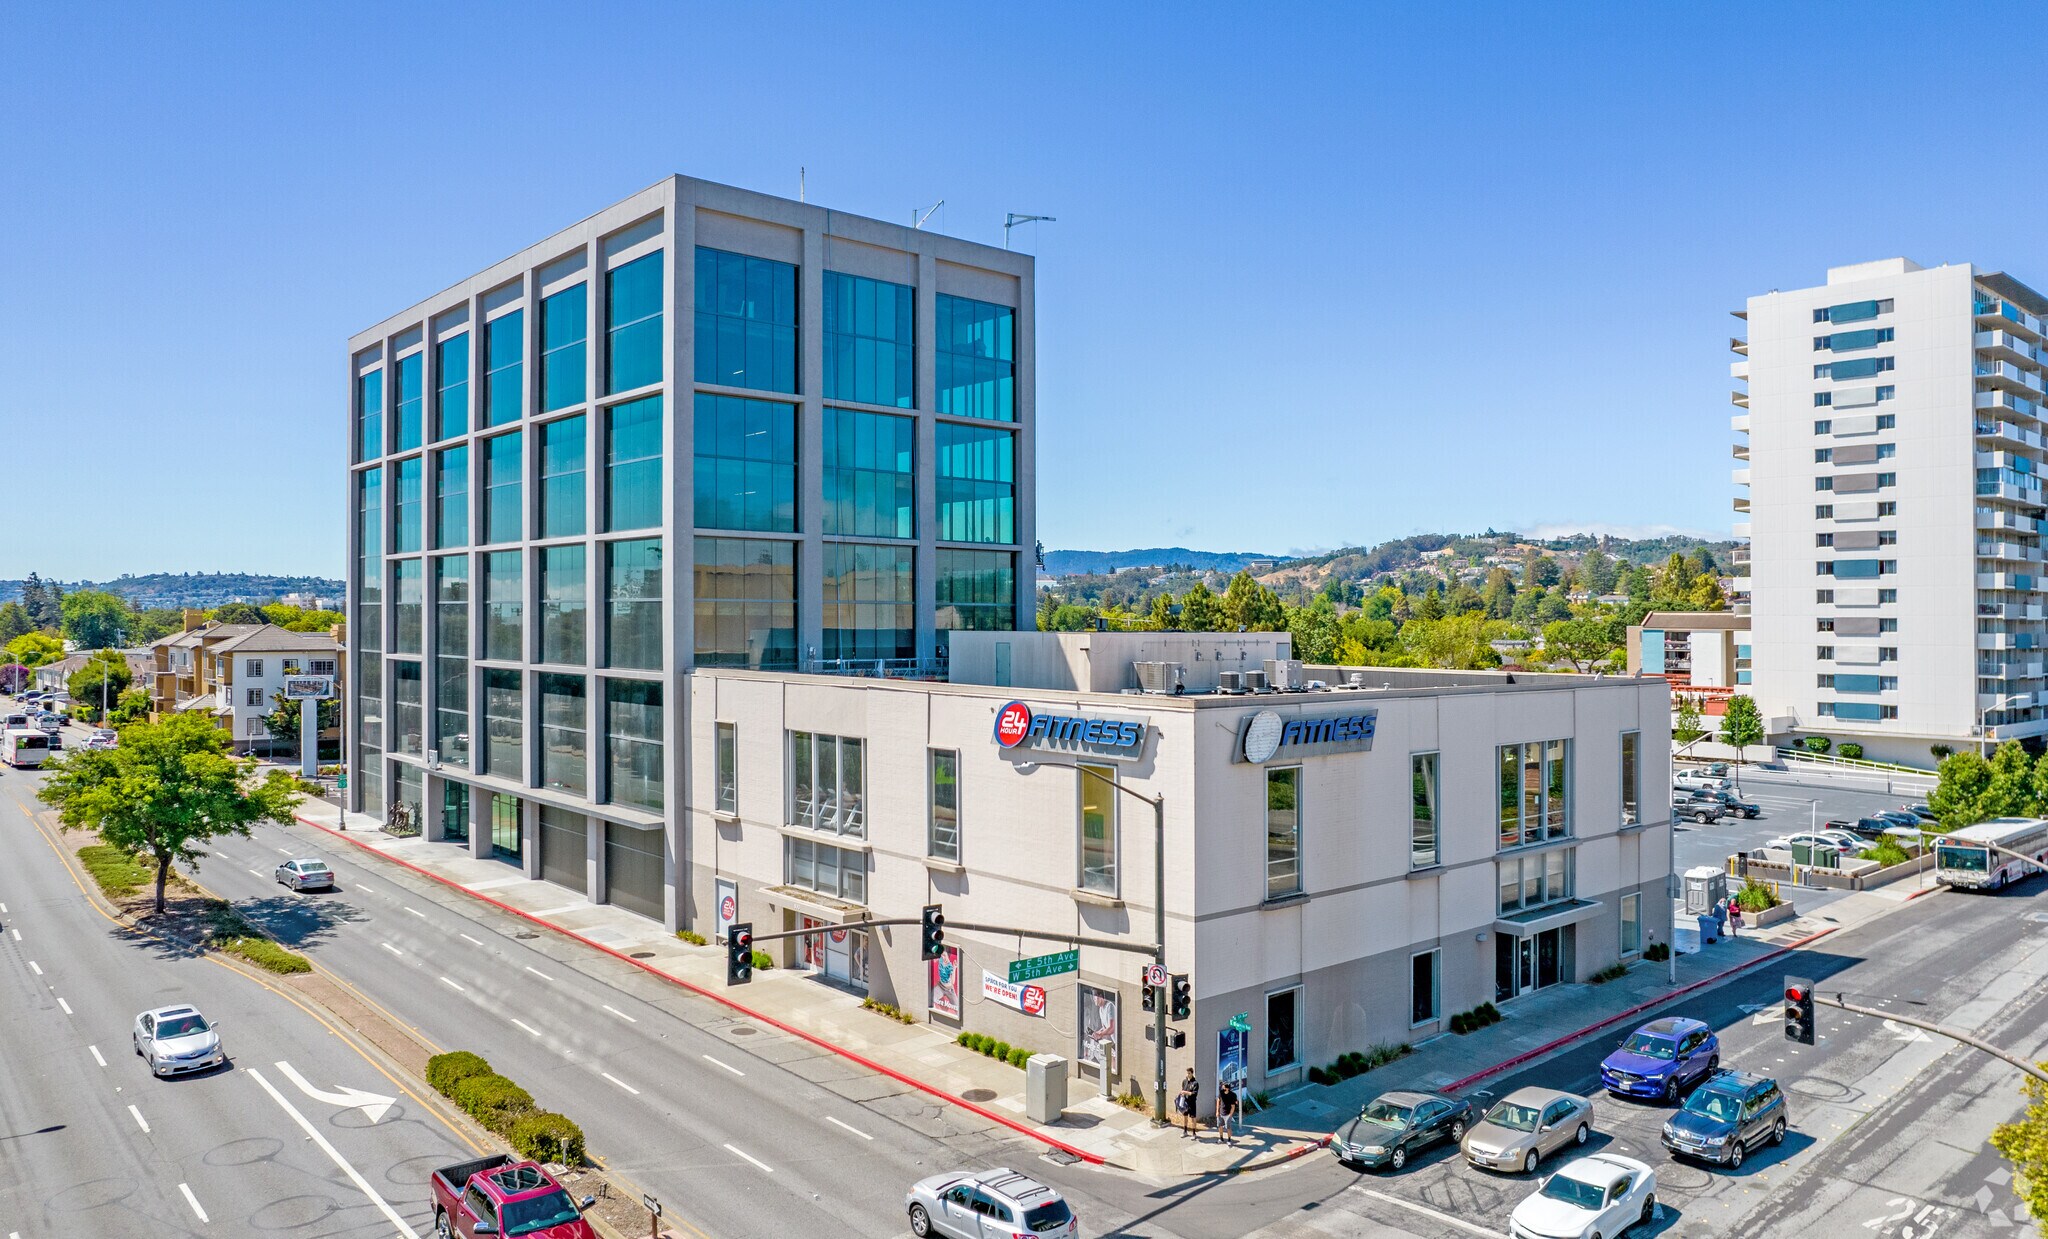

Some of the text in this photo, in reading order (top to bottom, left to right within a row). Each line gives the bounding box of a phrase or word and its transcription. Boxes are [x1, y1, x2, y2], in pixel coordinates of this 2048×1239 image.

[1000, 727, 1018, 735] HOUR
[1001, 710, 1027, 735] 24
[1028, 713, 1137, 746] FITNESS
[1282, 715, 1376, 746] FITNESS
[1026, 953, 1074, 968] E 5th Ave
[1012, 965, 1062, 981] W 5th Ave
[985, 983, 1018, 1001] WE'RE OPEN!
[1025, 987, 1044, 1006] 24
